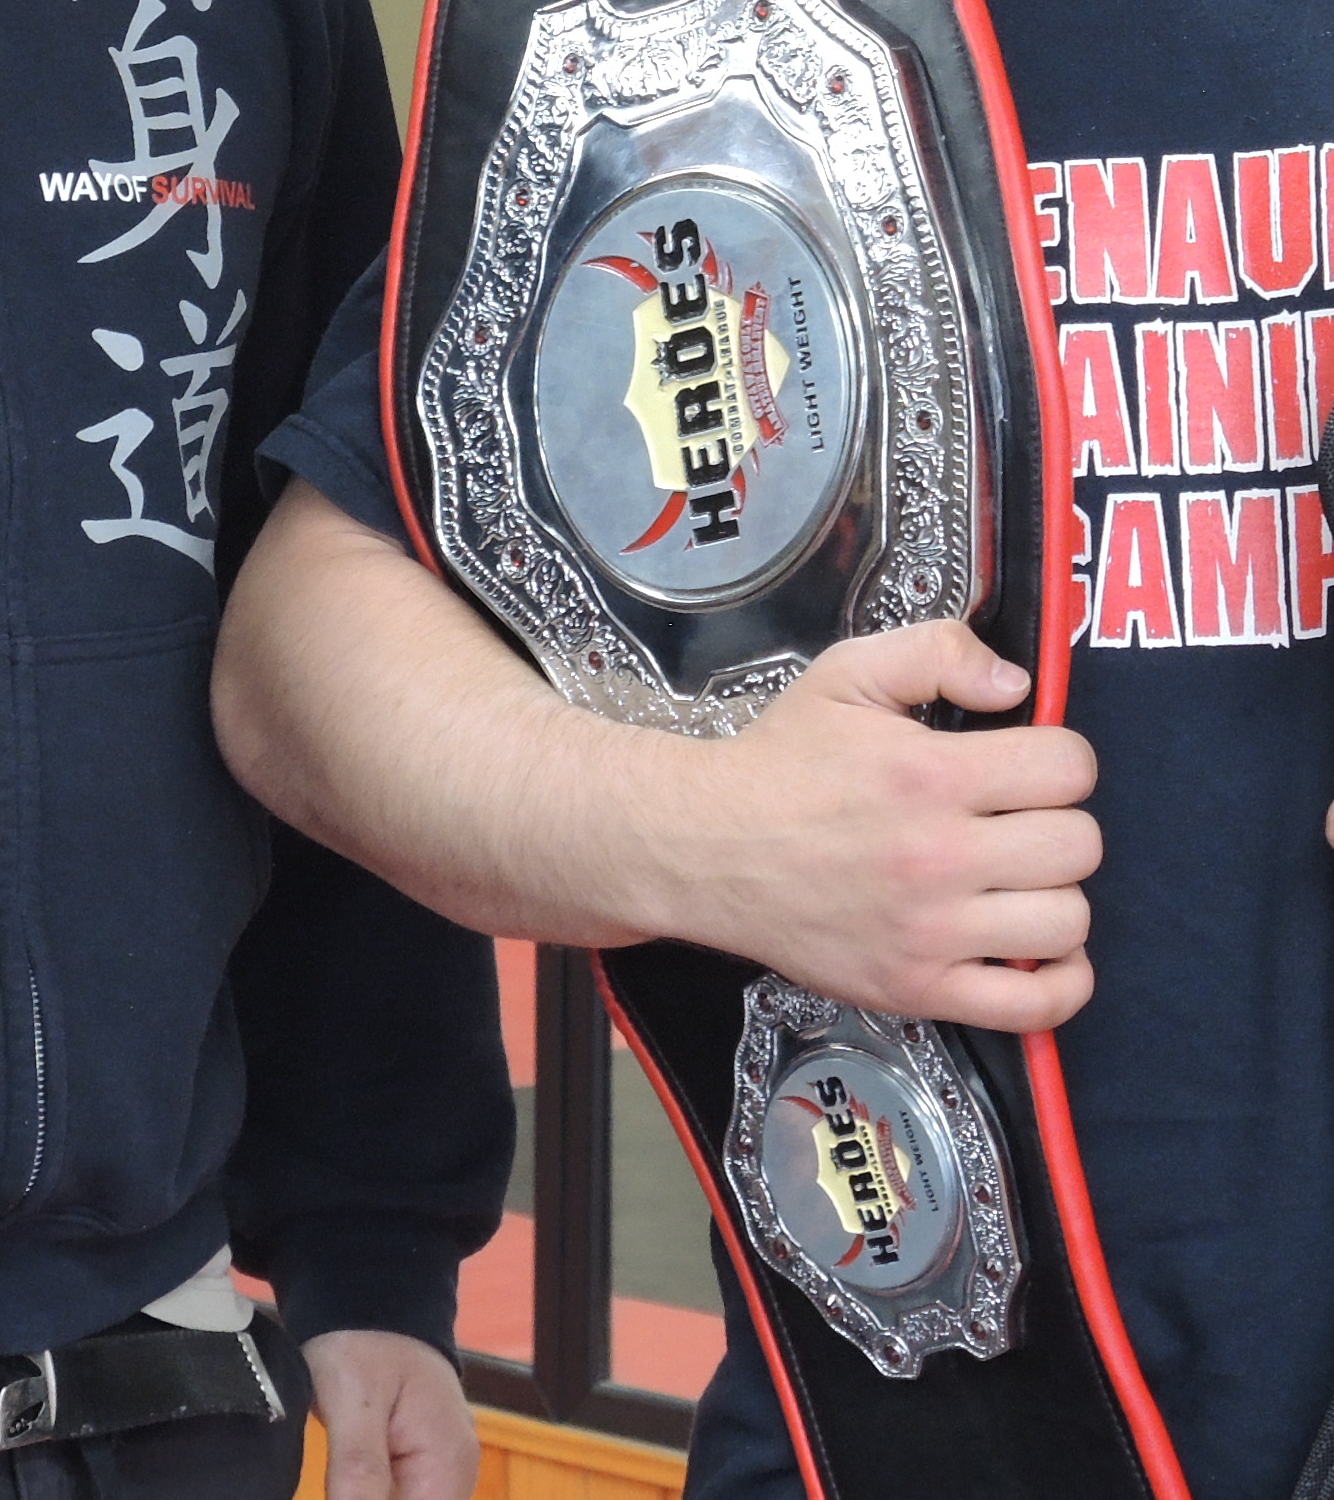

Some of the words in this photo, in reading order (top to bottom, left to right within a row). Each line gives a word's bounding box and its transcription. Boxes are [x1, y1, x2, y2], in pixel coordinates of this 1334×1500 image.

[151, 175, 257, 210] SURVIVAL
[788, 276, 812, 374] WEIGHT
[652, 217, 741, 548] HEROES
[803, 380, 825, 454] LIGHT
[815, 1076, 899, 1266] HEROES
[898, 1110, 924, 1166] WEIGHT
[919, 1171, 940, 1213] LIGHT
